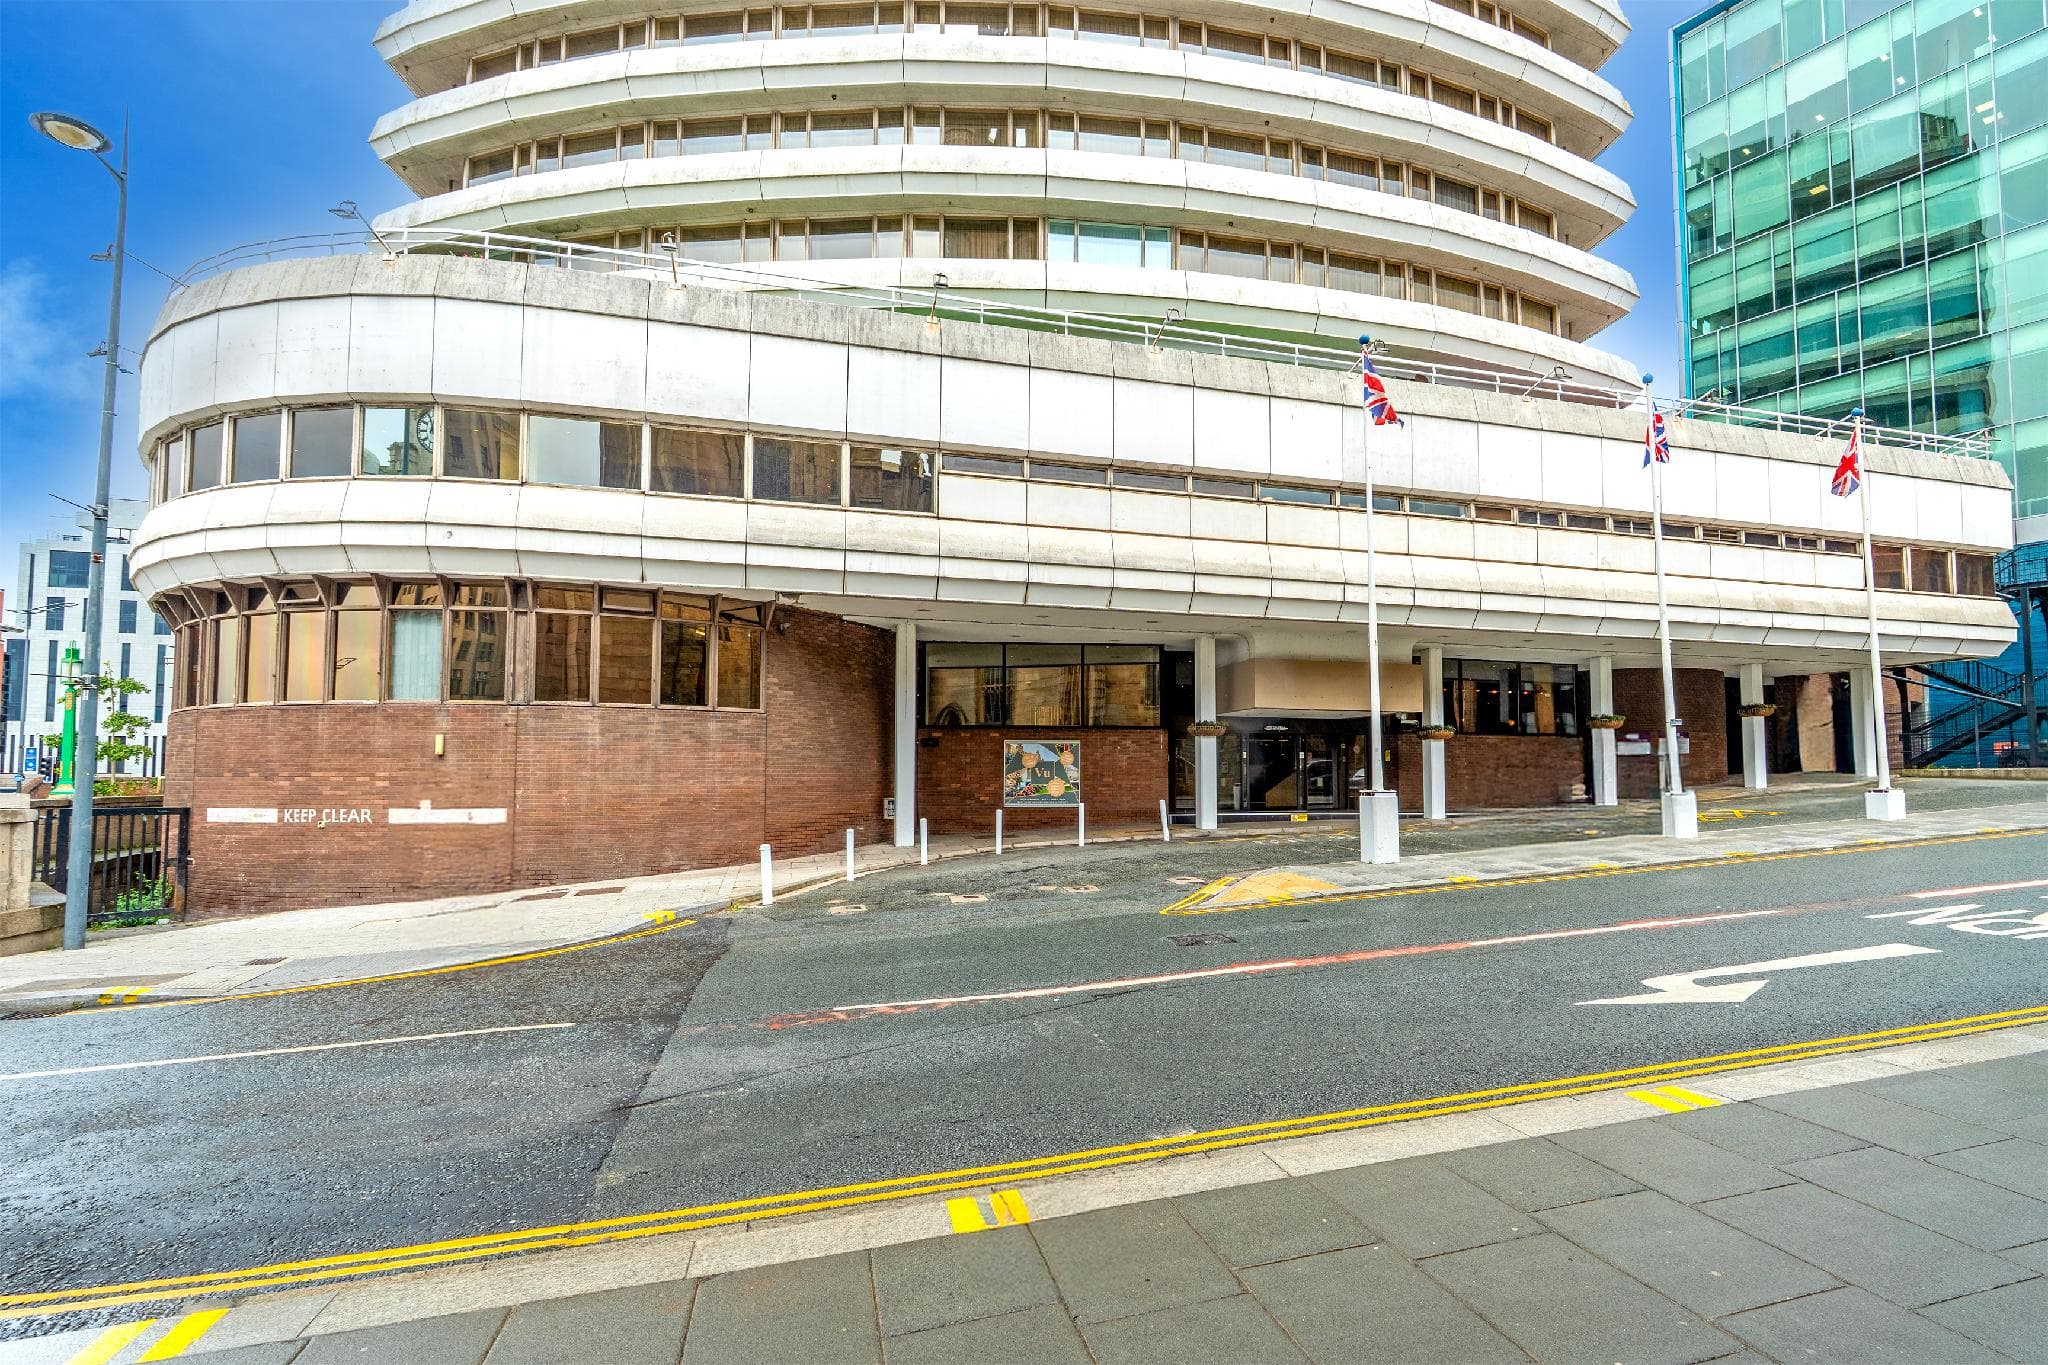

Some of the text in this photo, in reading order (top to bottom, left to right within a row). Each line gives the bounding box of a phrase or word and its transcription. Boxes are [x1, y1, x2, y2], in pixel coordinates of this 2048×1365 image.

[1034, 767, 1051, 778] Vu
[283, 808, 373, 824] KEEP CLEAR
